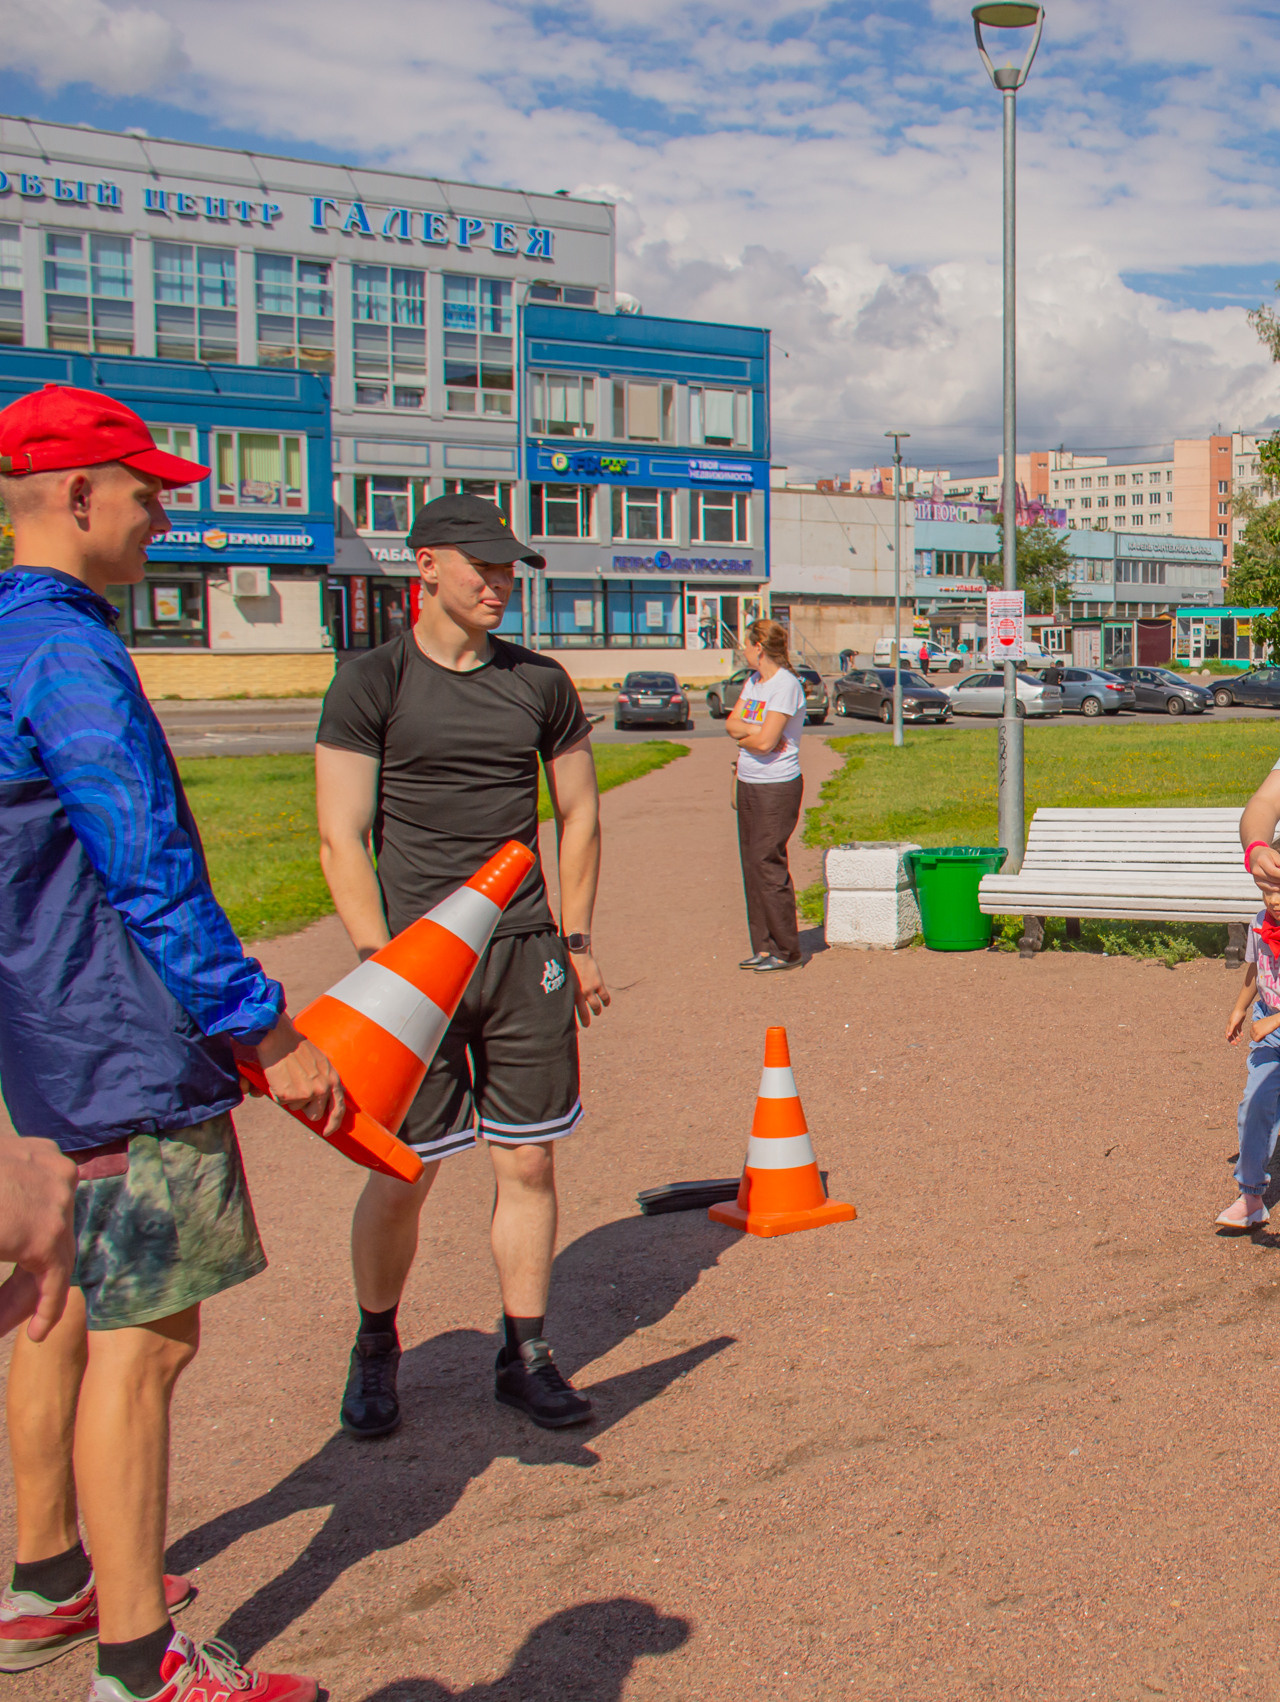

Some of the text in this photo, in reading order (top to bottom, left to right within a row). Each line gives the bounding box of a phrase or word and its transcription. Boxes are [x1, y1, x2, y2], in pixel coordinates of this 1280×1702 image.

[143, 188, 282, 225] ЦЕНТР
[310, 197, 555, 259] ГАЛЕРЕЯ
[228, 532, 314, 547] ЕРМОЛИНО
[354, 579, 366, 630] ТАБАК
